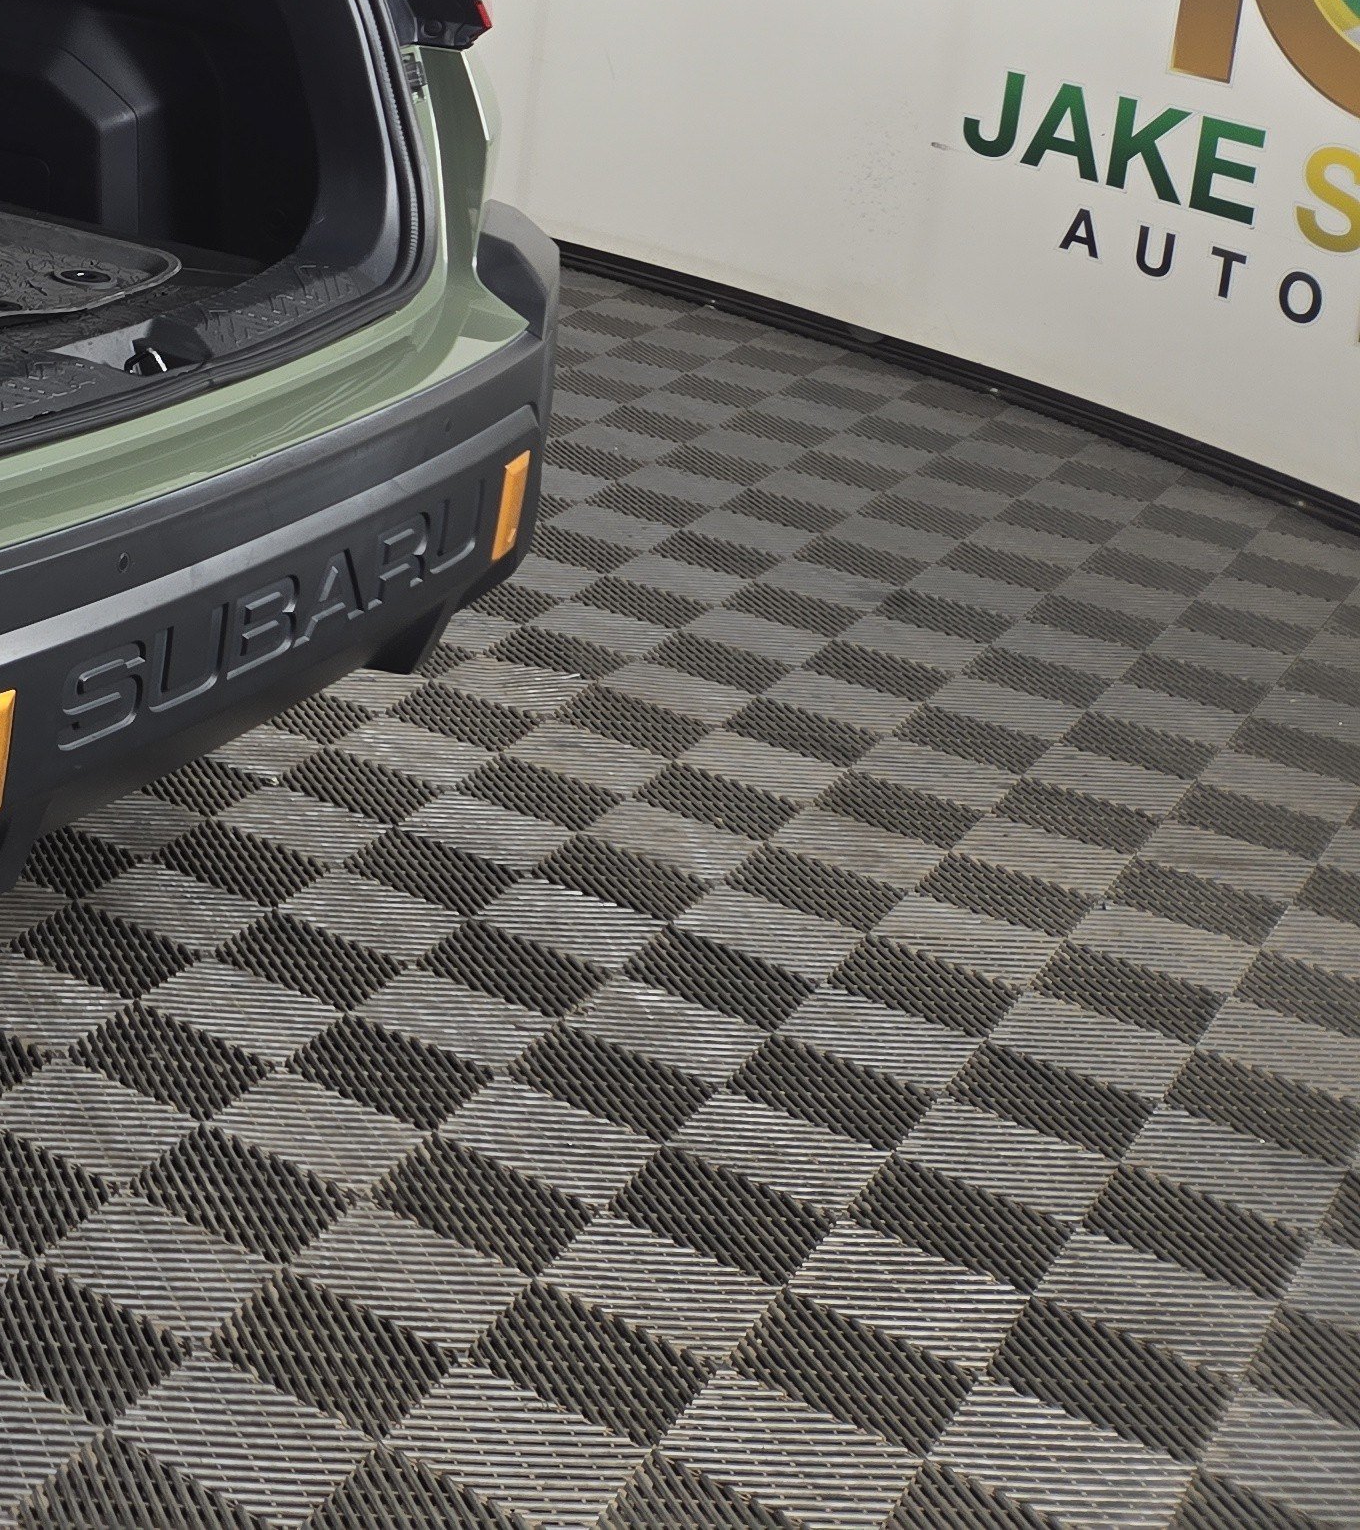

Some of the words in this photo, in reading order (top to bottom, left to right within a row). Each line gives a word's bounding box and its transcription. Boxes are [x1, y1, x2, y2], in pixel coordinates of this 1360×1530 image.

[963, 71, 1267, 227] JAKE
[1058, 208, 1323, 325] AUTO
[57, 477, 485, 752] SUBARU
